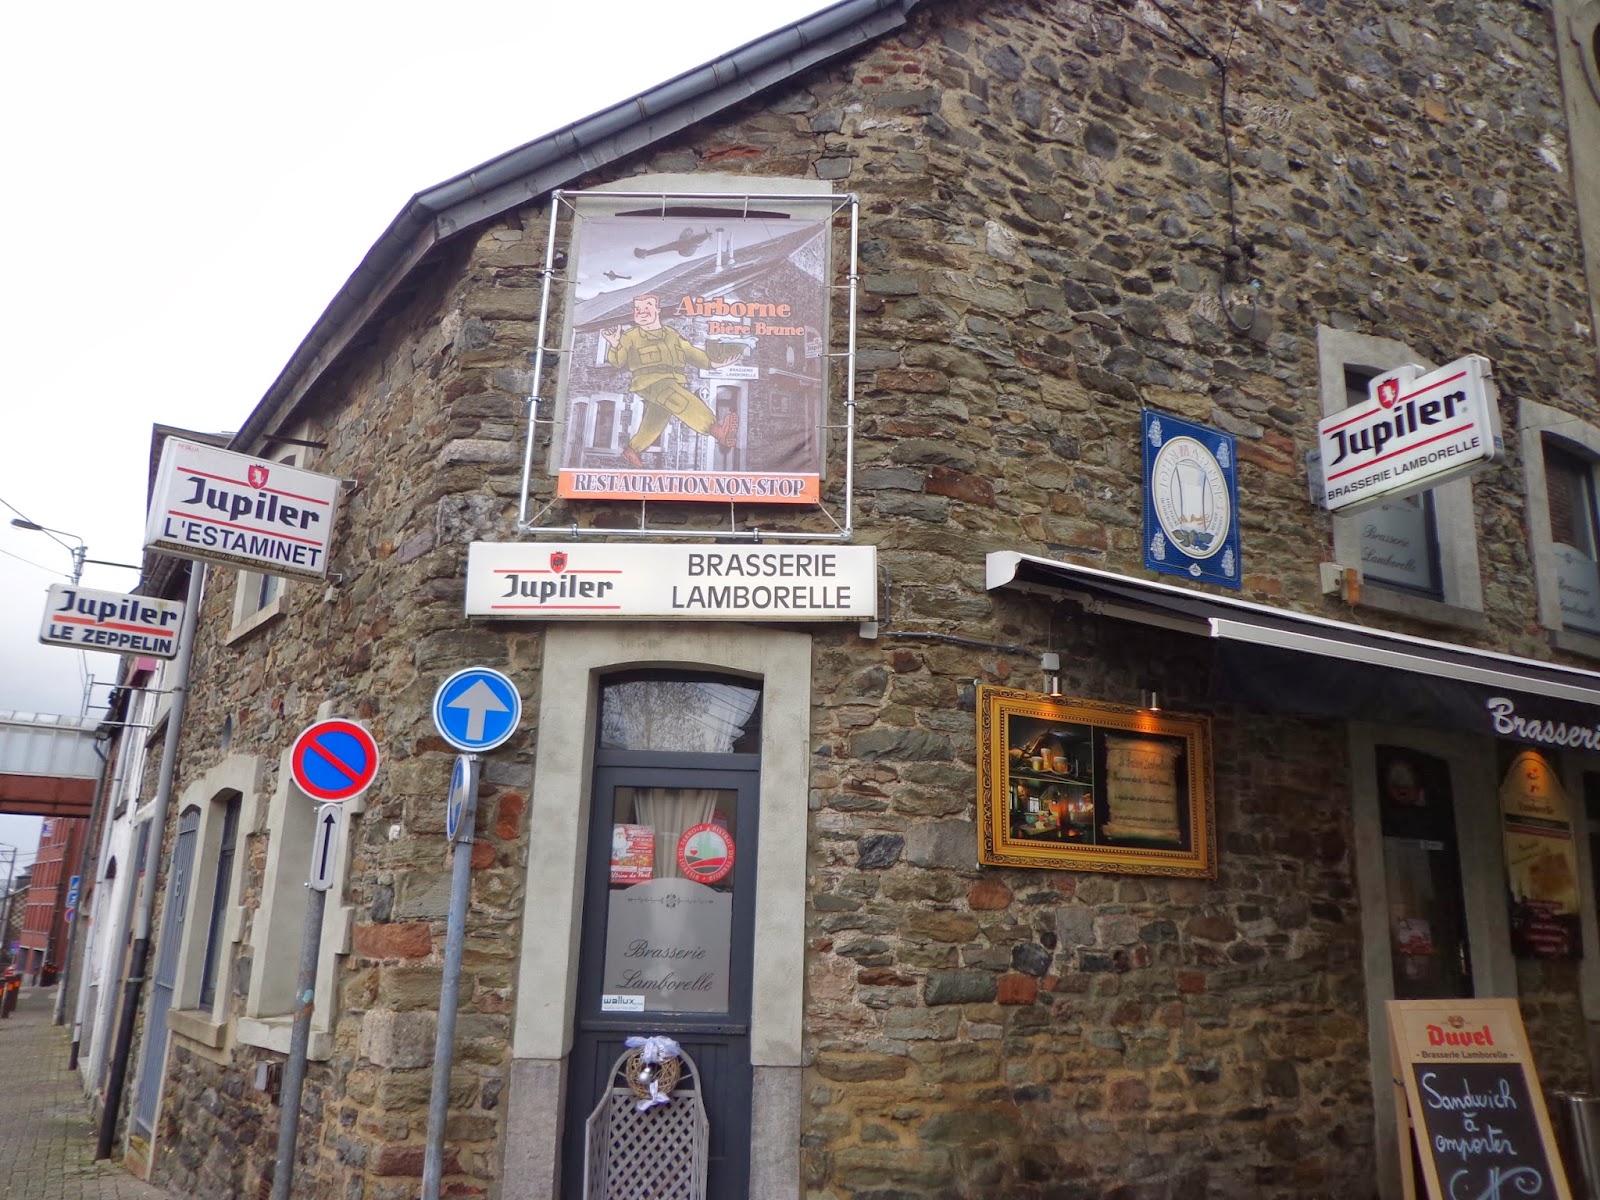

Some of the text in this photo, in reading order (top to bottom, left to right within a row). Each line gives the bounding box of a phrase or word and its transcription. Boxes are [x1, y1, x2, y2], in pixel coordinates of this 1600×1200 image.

[673, 295, 791, 318] Airborne
[708, 321, 751, 335] Bière
[1329, 390, 1466, 467] Jupiler
[1328, 437, 1480, 500] BRASSERIE LAMBORELLE
[574, 474, 804, 497] RESTAURATION NON-STOP
[180, 476, 320, 529] Jupiler
[164, 518, 322, 567] L'ESTAMINET
[688, 553, 836, 577] BRASSERIE
[501, 574, 613, 604] Jupiler
[672, 585, 851, 609] LAMBORELLE
[56, 590, 178, 626] Jupiler
[50, 624, 172, 653] LE ZEPPELIN
[624, 939, 706, 959] Brasserie
[616, 969, 714, 991] Lamborelle
[604, 996, 634, 1004] wallux
[1426, 1025, 1494, 1047] Duvel
[1421, 1051, 1508, 1059] Brasserie Lamborelle
[1422, 1073, 1517, 1109] Sandwich
